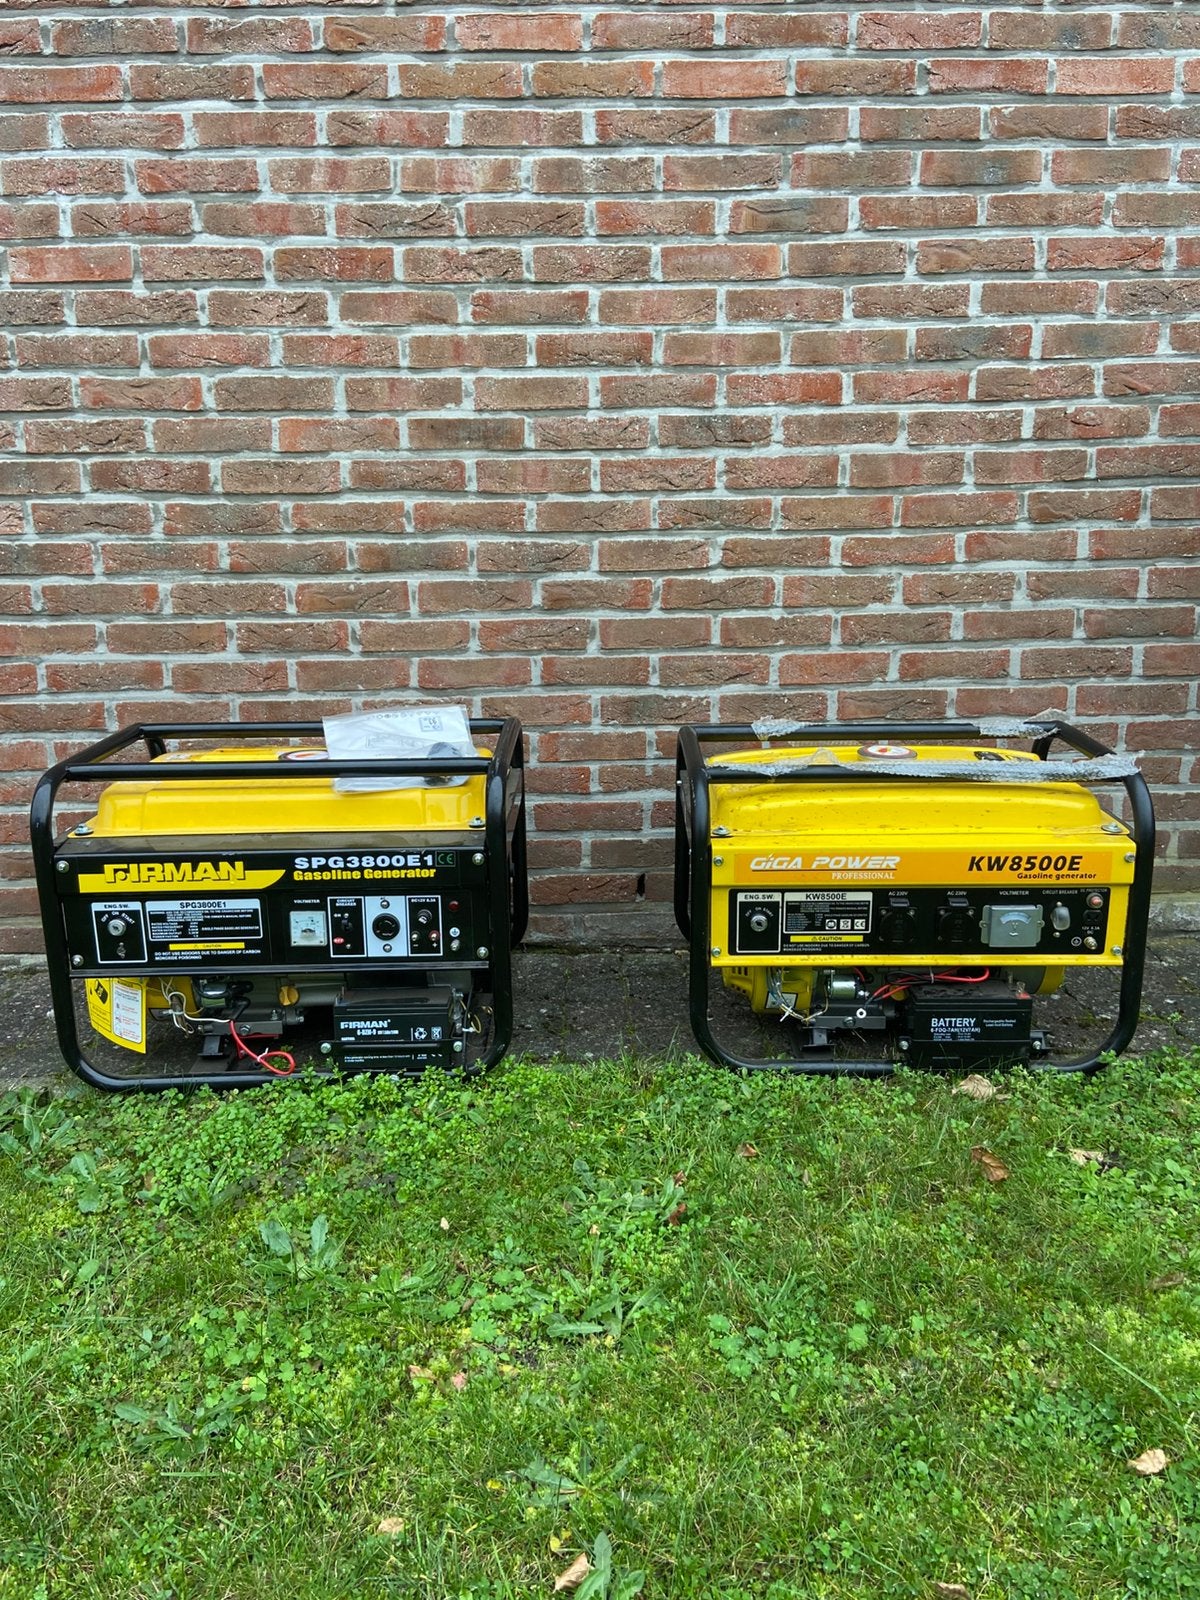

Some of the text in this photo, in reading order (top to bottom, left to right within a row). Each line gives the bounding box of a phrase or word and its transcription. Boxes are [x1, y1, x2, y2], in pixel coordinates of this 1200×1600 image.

[294, 854, 434, 869] SPG3800E1
[811, 856, 900, 870] POWER
[968, 855, 1083, 872] KW8500E
[103, 861, 245, 884] FIRMAN
[293, 868, 436, 881] Gasoline Generator
[831, 871, 895, 880] PROFESSIONAL
[1017, 872, 1097, 881] Gasoline generator
[805, 892, 848, 900] KW8500E
[179, 900, 227, 909] SPG3800E1
[121, 912, 136, 924] START
[340, 1020, 388, 1029] FIRMAN
[931, 1017, 976, 1027] BATTERY
